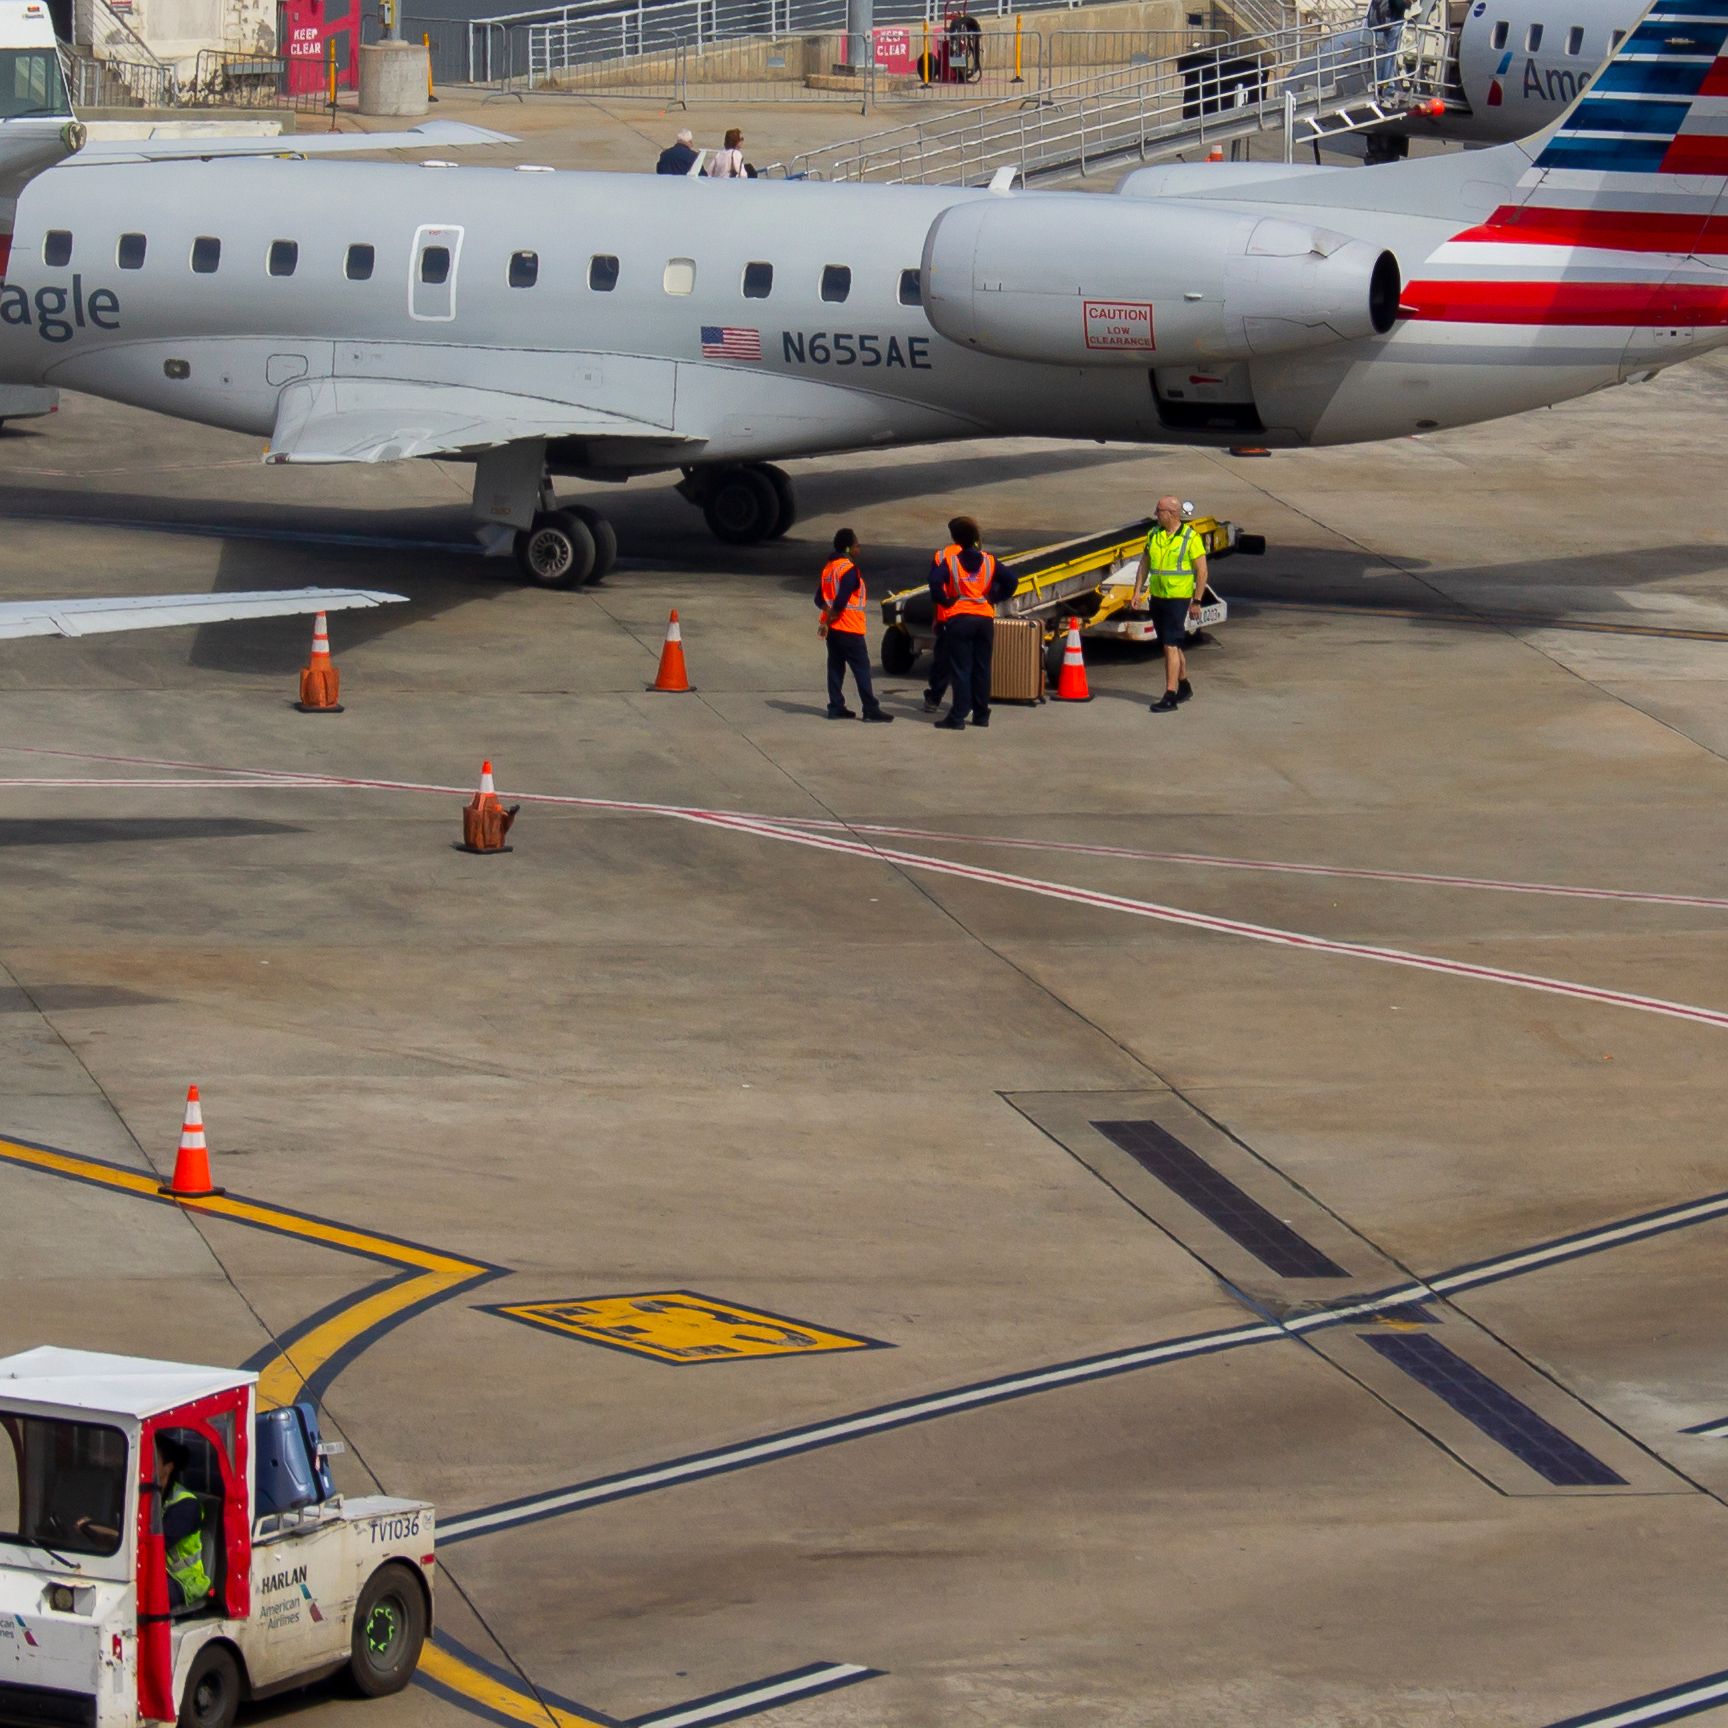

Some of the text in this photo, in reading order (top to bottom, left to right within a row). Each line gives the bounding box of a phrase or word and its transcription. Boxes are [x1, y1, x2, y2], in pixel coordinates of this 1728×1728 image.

[293, 28, 318, 40] KEEP
[290, 42, 321, 55] CLEAR
[876, 44, 907, 57] CLEAR
[0, 274, 120, 343] agle
[1088, 307, 1147, 321] CAUTION
[1106, 326, 1130, 335] LOW
[1089, 336, 1151, 347] CLEARANCE
[781, 330, 932, 370] N655AE
[371, 1517, 419, 1543] TV1036
[261, 1565, 308, 1595] HARLAN
[260, 1597, 300, 1619] American
[267, 1611, 300, 1630] Airlines
